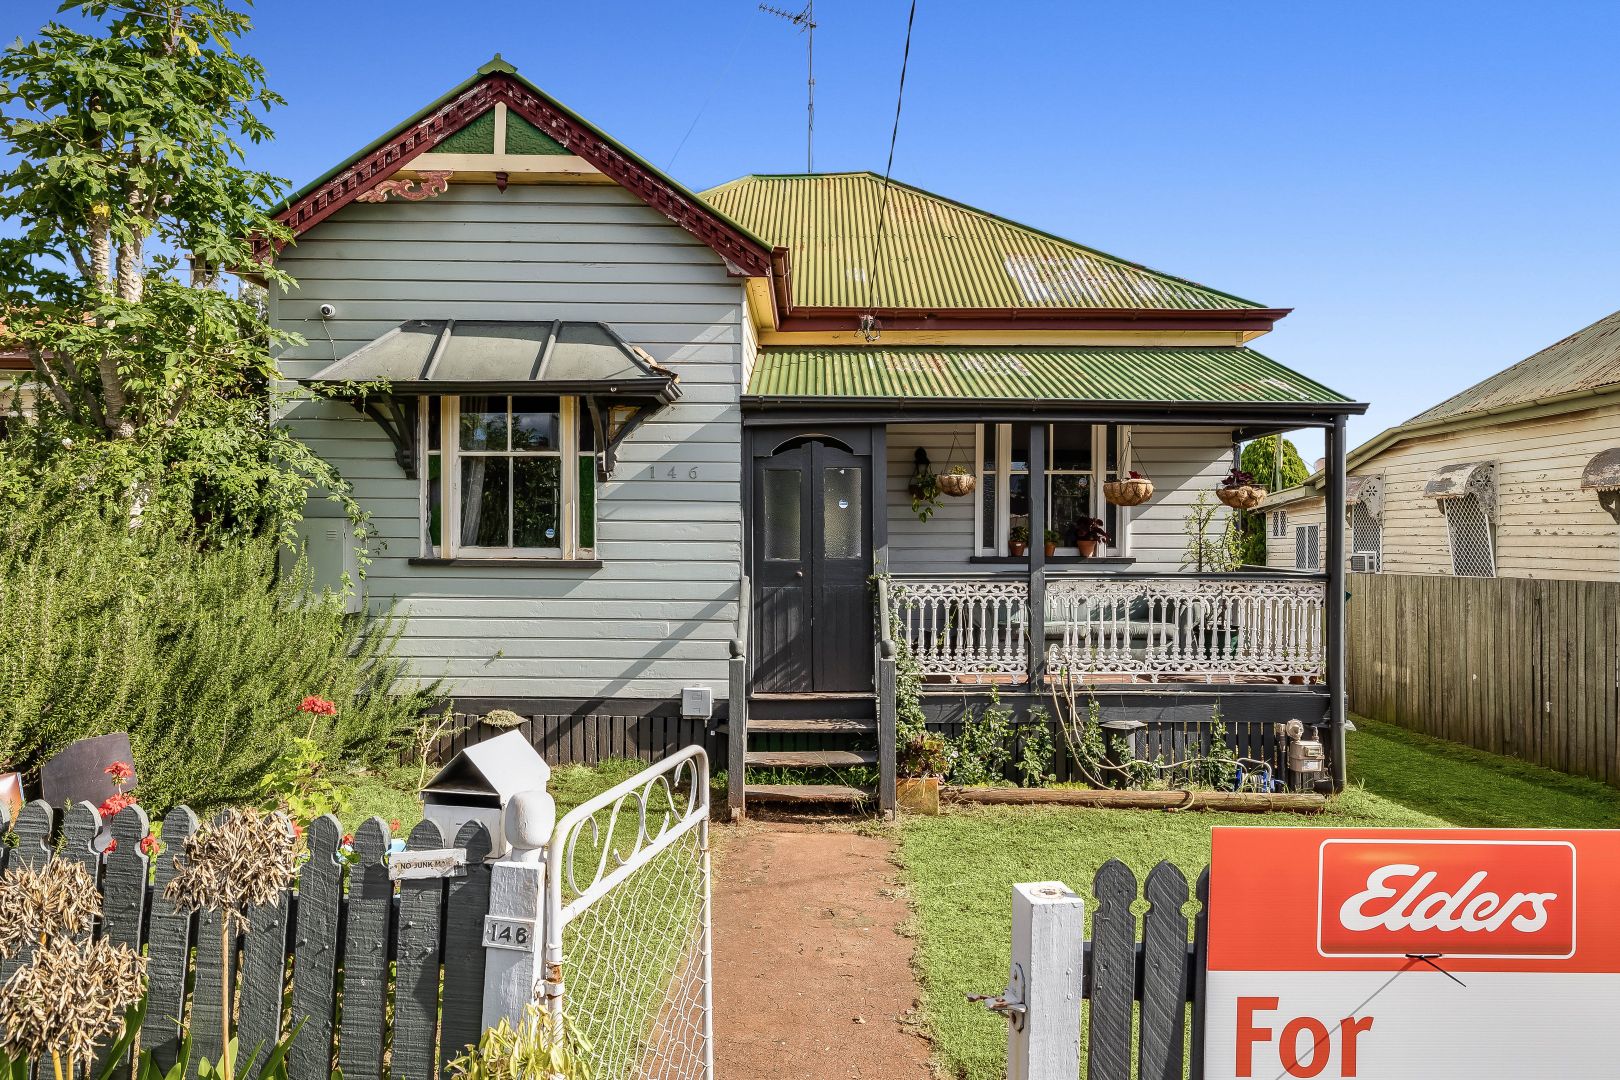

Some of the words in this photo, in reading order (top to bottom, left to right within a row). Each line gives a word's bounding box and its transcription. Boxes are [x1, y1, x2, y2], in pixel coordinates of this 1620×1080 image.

[649, 466, 698, 480] 146
[400, 862, 412, 870] NO
[413, 861, 434, 869] JUNK
[1339, 863, 1557, 932] Elders
[491, 922, 528, 944] 146
[1235, 996, 1374, 1079] For
